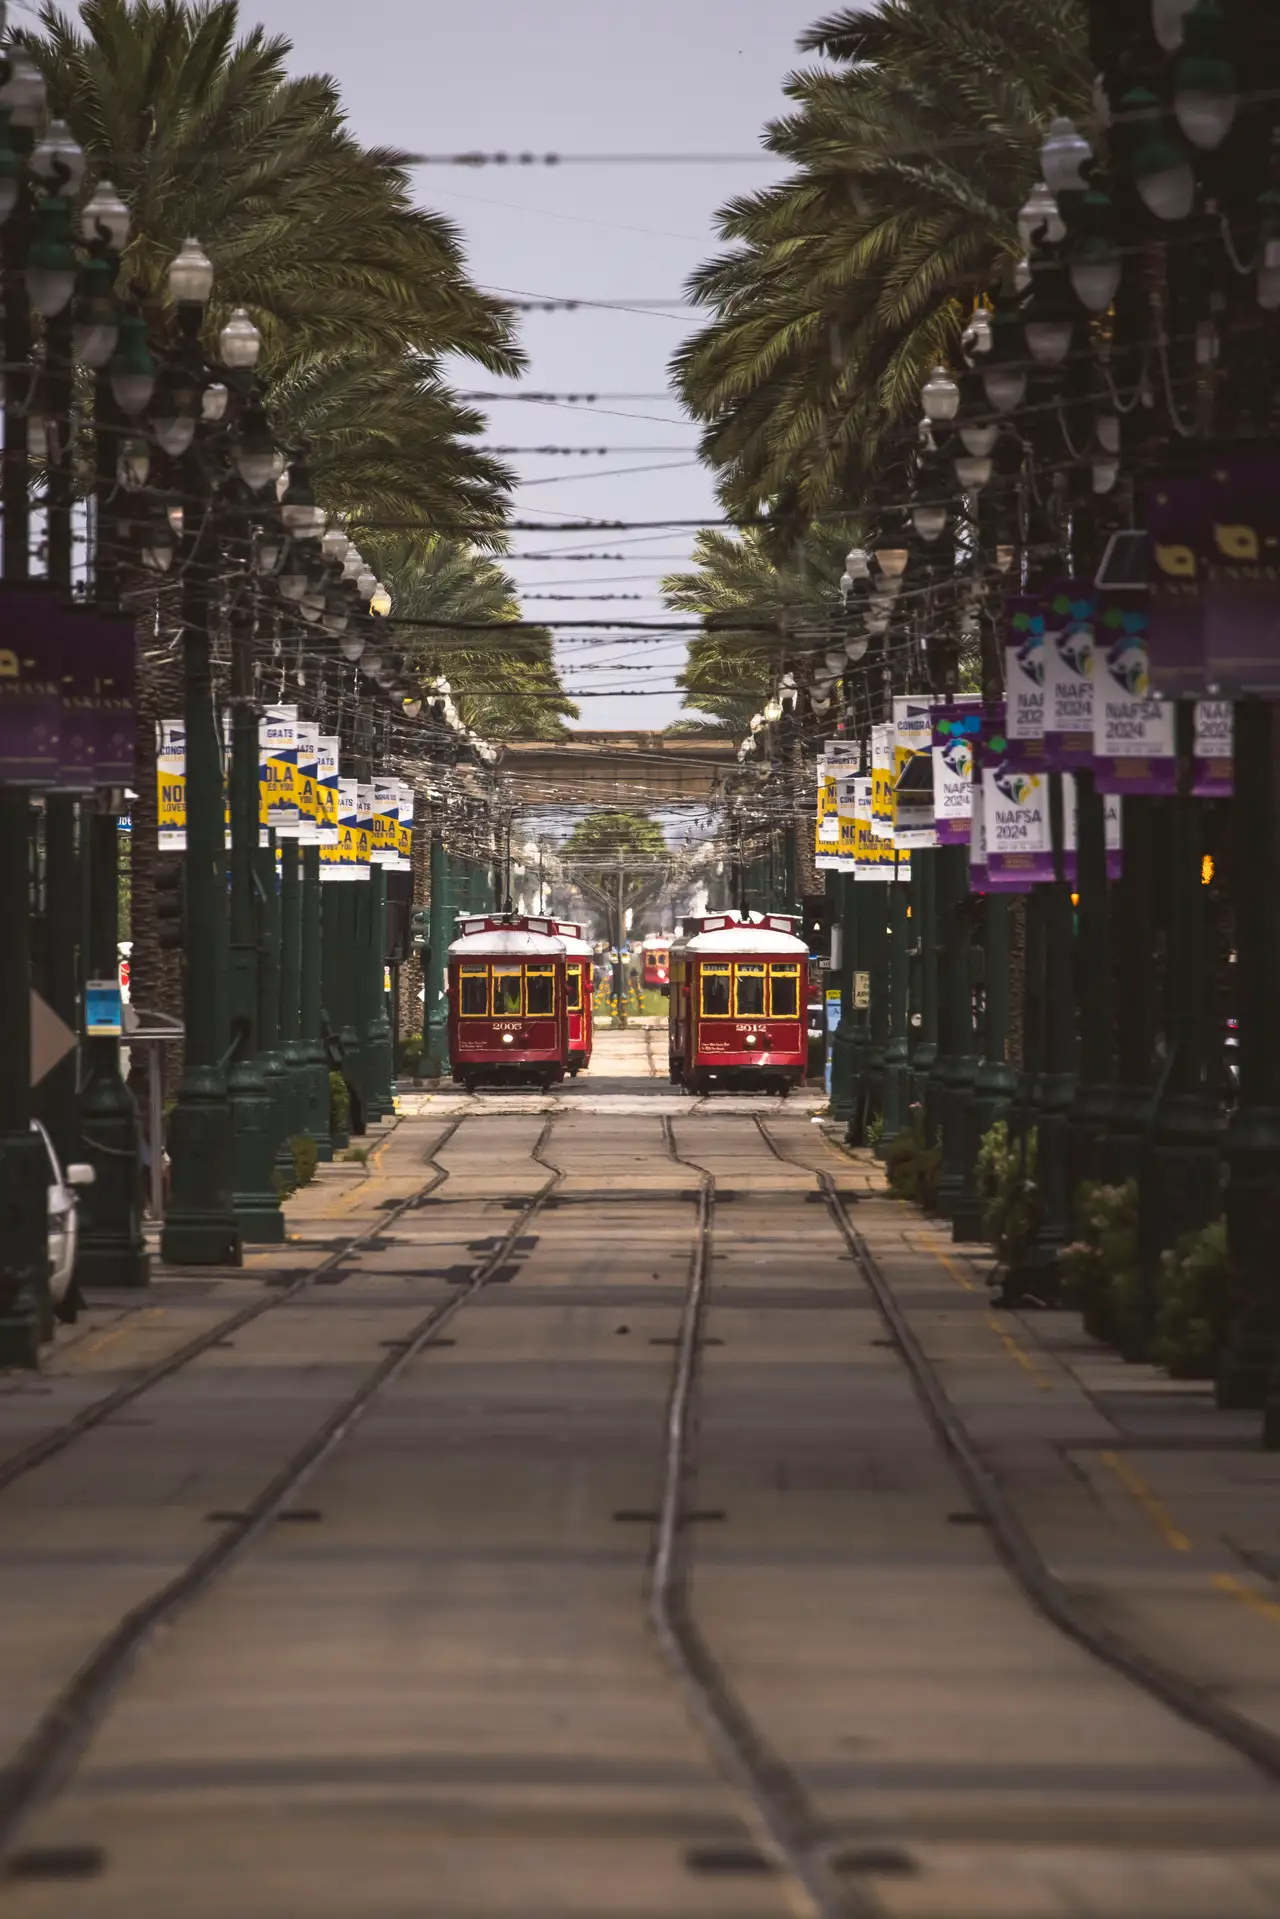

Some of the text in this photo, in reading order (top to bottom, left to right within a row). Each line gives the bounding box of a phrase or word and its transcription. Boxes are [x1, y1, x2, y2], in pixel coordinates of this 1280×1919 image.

[1055, 701, 1091, 716] 2024
[1105, 703, 1162, 720] NAFSA
[1105, 722, 1145, 738] 2024
[944, 796, 970, 807] 2024
[996, 809, 1041, 824] NAFSA
[996, 825, 1027, 838] 2024
[492, 1022, 522, 1031] 2005
[736, 1024, 767, 1032] 2012
